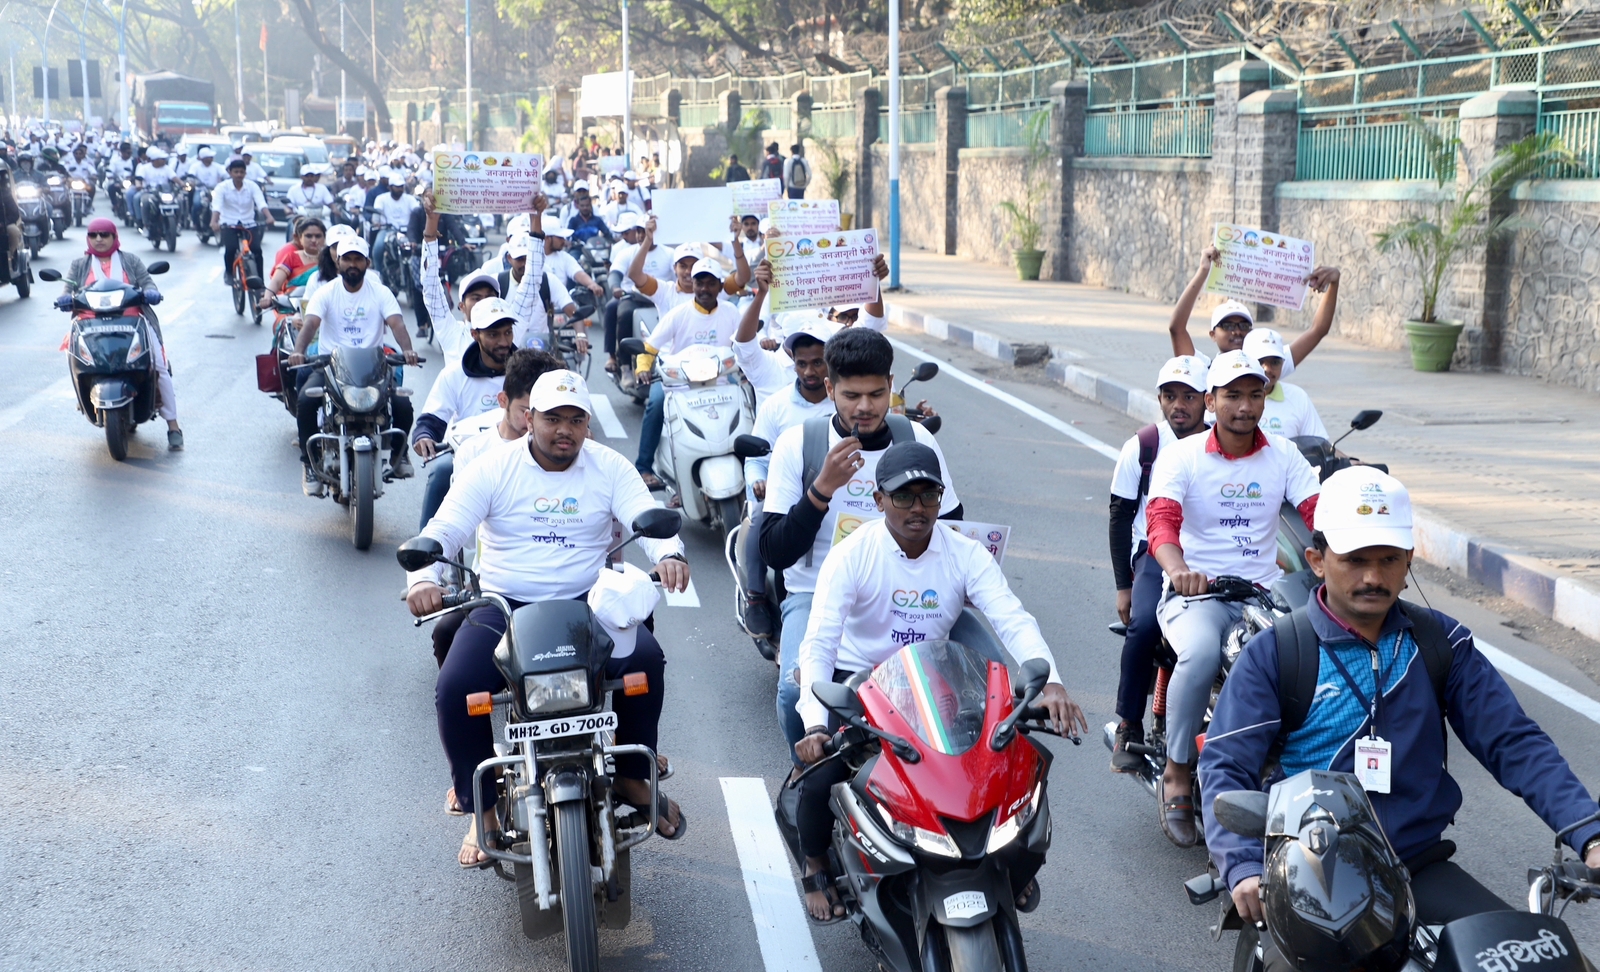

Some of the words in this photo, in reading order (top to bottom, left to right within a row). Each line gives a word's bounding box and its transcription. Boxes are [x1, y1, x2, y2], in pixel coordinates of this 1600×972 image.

[485, 169, 521, 179] जनजागृती
[819, 247, 857, 260] जनजागृती
[860, 246, 874, 255] फेरी
[1262, 248, 1295, 262] जनजागृती
[796, 276, 816, 286] शिखर
[817, 274, 837, 283] परिषद
[839, 270, 870, 281] जनजागृती
[807, 287, 819, 297] युवा
[821, 285, 833, 294] दिन
[847, 479, 875, 497] G2
[1219, 514, 1250, 529] राष्ट्रीय
[948, 900, 986, 914] 2025
